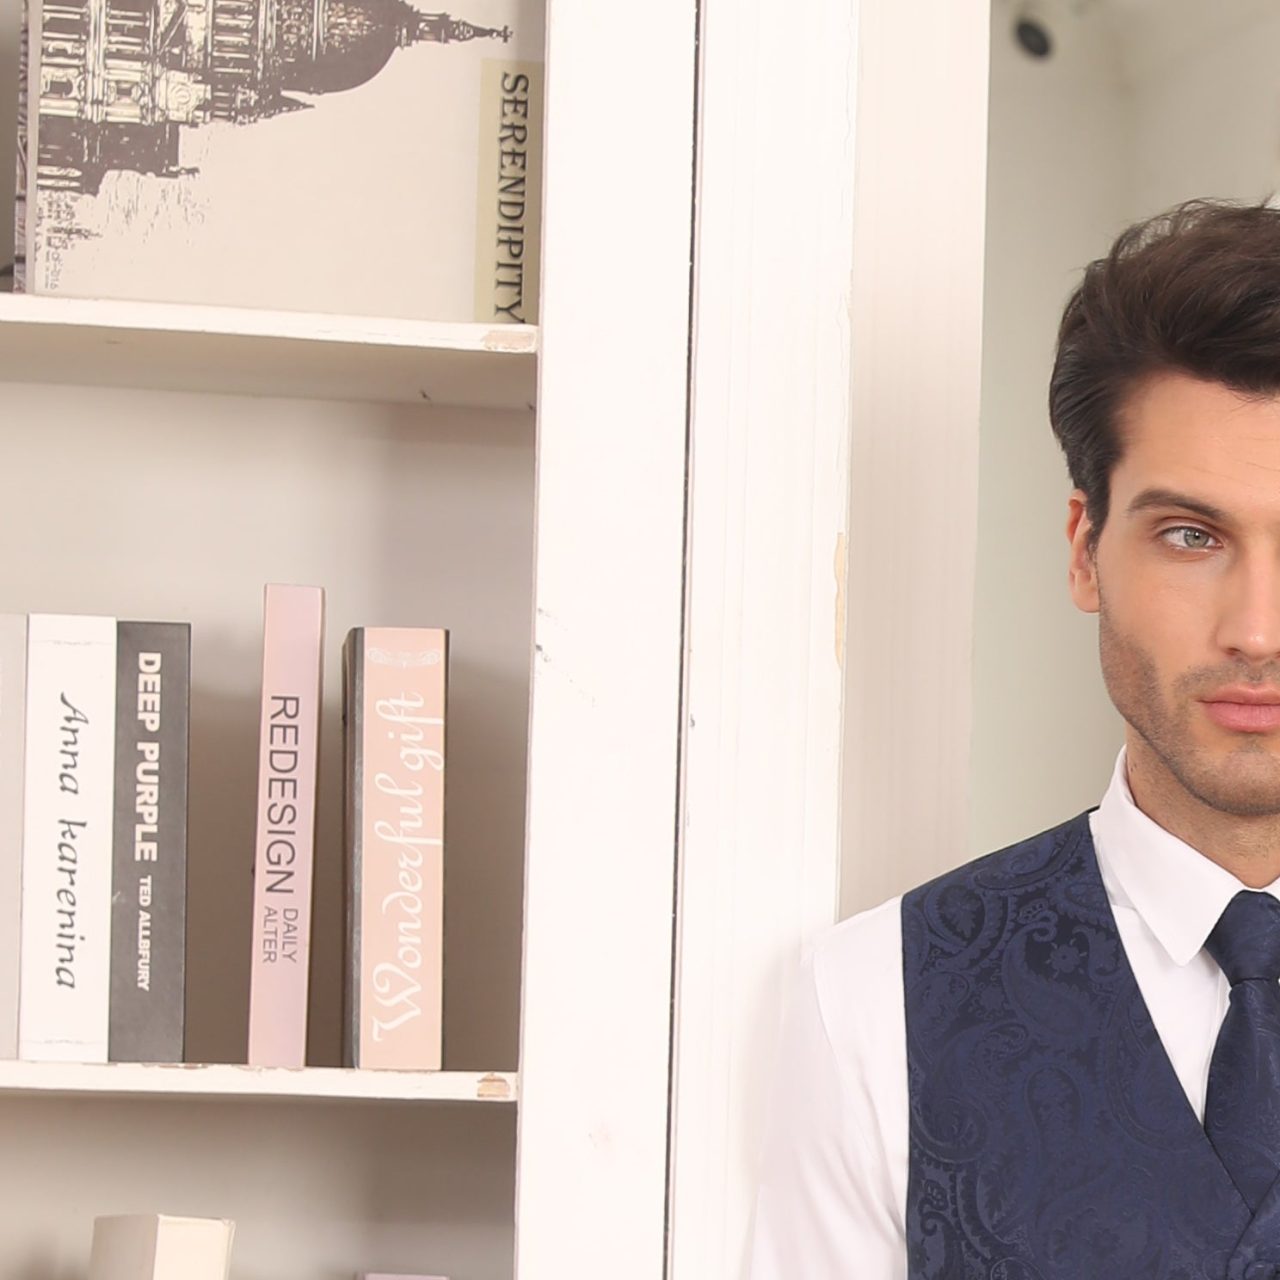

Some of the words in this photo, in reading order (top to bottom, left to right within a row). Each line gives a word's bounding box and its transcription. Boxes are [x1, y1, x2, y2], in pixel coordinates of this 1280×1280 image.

[494, 72, 531, 325] SERENDIPITY
[59, 691, 90, 796] Anna
[137, 652, 163, 733] DEEP
[374, 690, 445, 772] gift
[134, 741, 161, 862] PURPLE
[264, 695, 301, 895] REDESIGN
[55, 818, 88, 990] karenina
[138, 874, 153, 908] TED
[262, 905, 279, 964] ALTER
[281, 907, 299, 964] DAILY
[371, 772, 444, 1043] Wonderful
